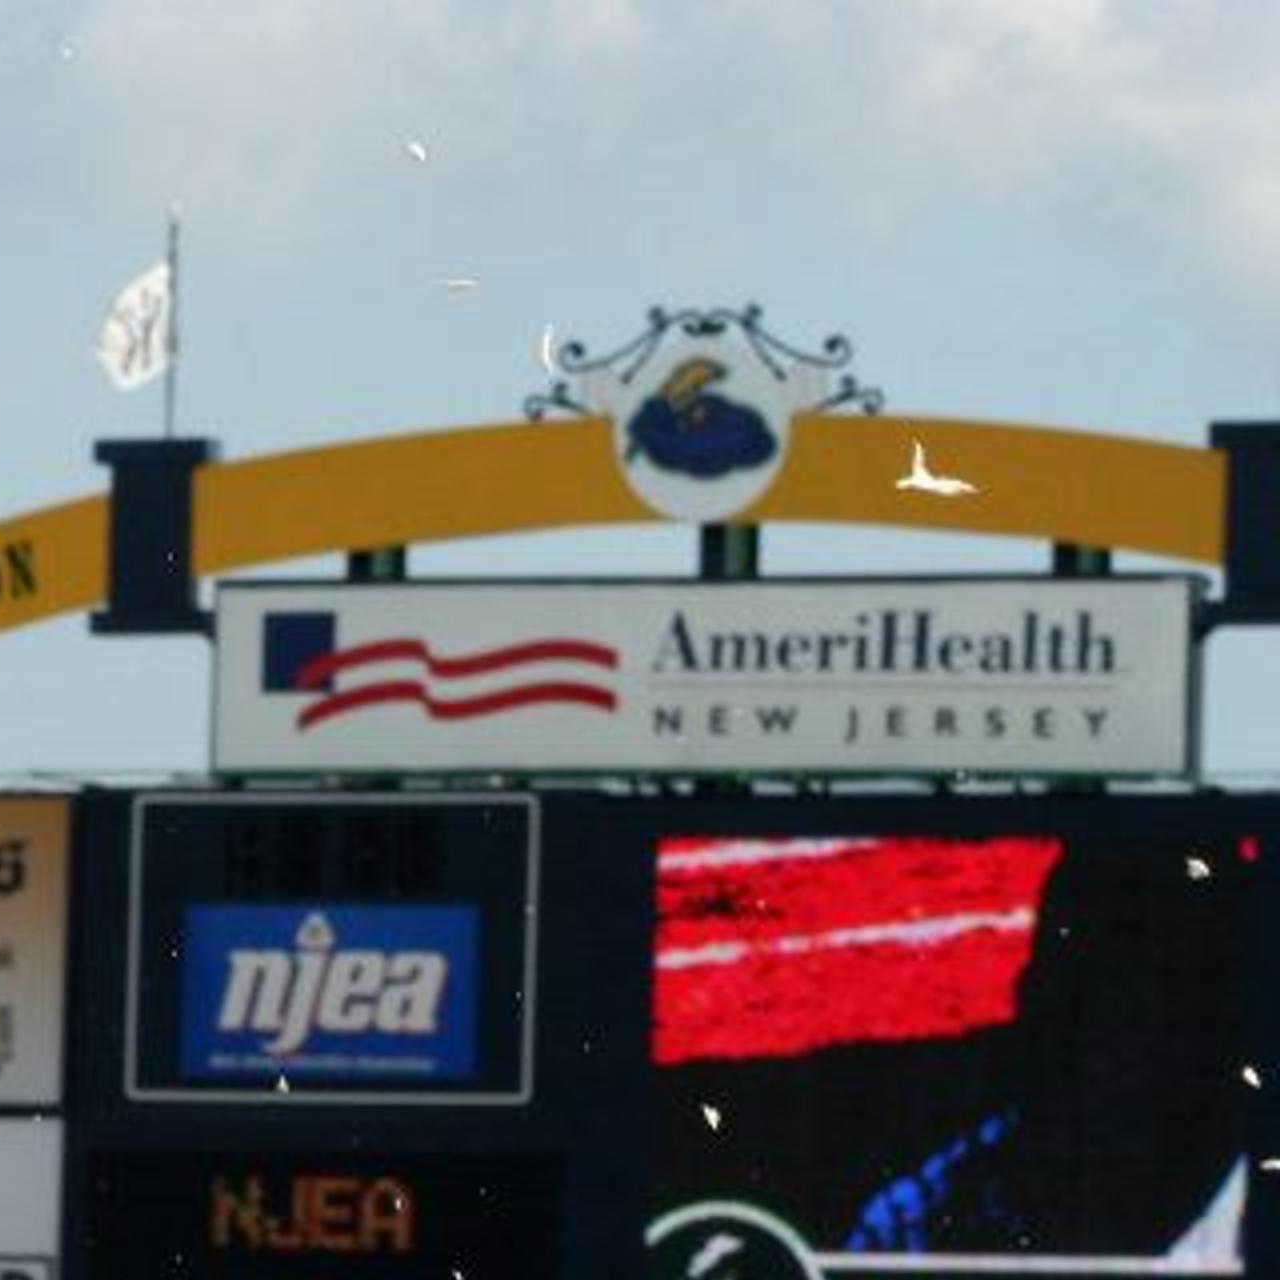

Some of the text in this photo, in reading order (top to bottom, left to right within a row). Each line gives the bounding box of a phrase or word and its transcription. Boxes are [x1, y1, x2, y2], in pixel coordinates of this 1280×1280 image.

[651, 608, 1118, 677] AmeriHealth
[653, 703, 1113, 740] NEW JERSEY
[218, 914, 448, 1058] njea
[212, 1175, 415, 1249] NJEA
